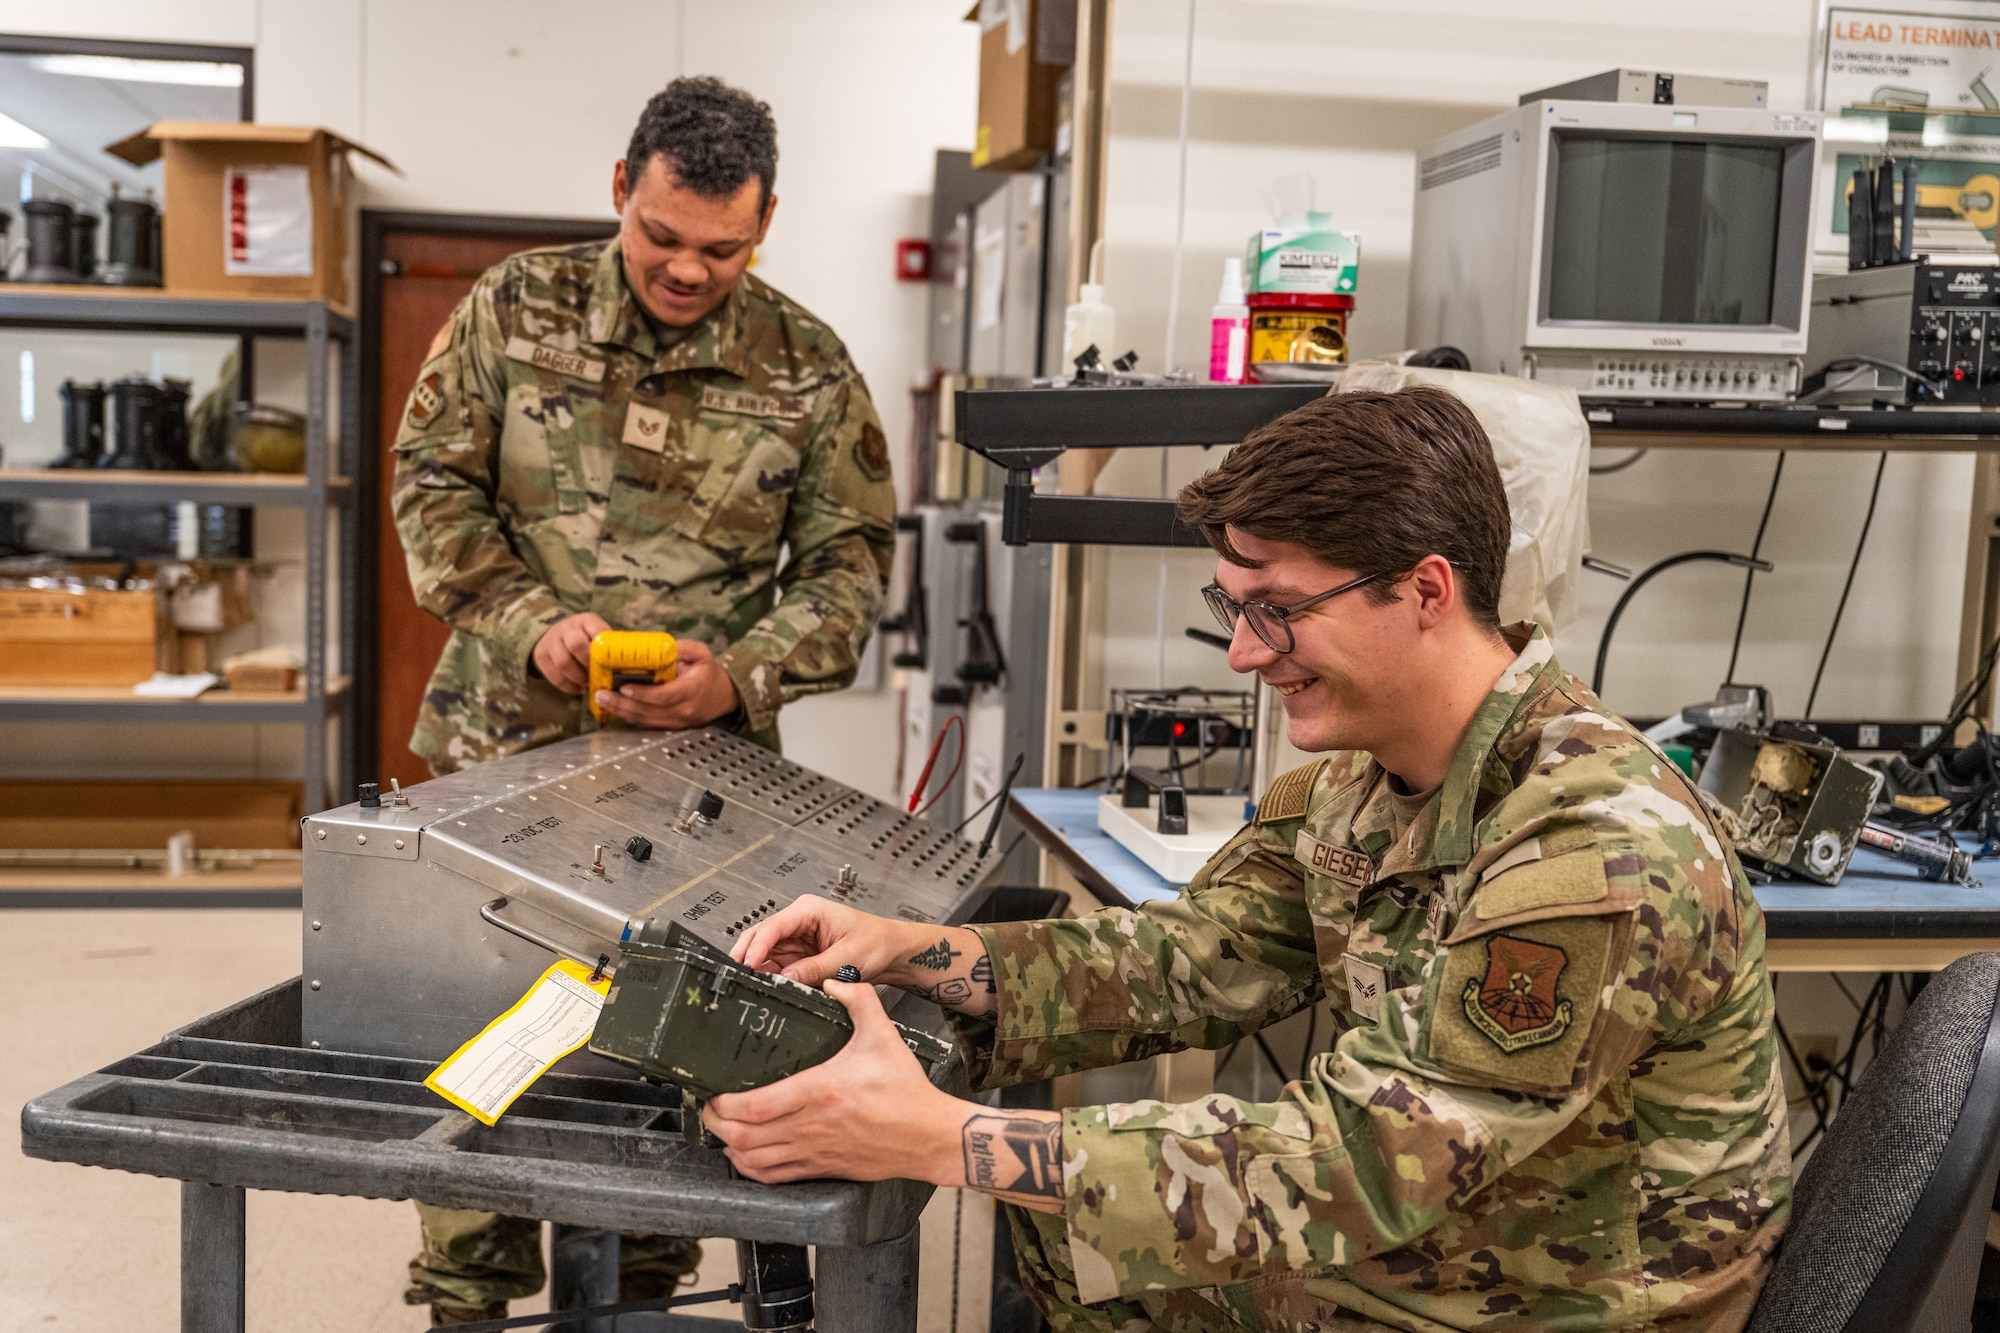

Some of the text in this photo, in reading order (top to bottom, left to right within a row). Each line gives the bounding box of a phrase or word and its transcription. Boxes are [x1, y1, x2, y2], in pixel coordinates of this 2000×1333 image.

[1835, 20, 1892, 43] LEAD
[1847, 64, 1910, 76] CONDUCTOR
[1897, 53, 1950, 67] DIRECTION
[1279, 254, 1339, 265] KIMTECH
[532, 347, 586, 375] DAGGER
[517, 826, 543, 838] VDC
[535, 816, 564, 829] TEST
[787, 852, 809, 865] TEST
[683, 891, 729, 920] OHMS TEST
[738, 999, 786, 1039] T311
